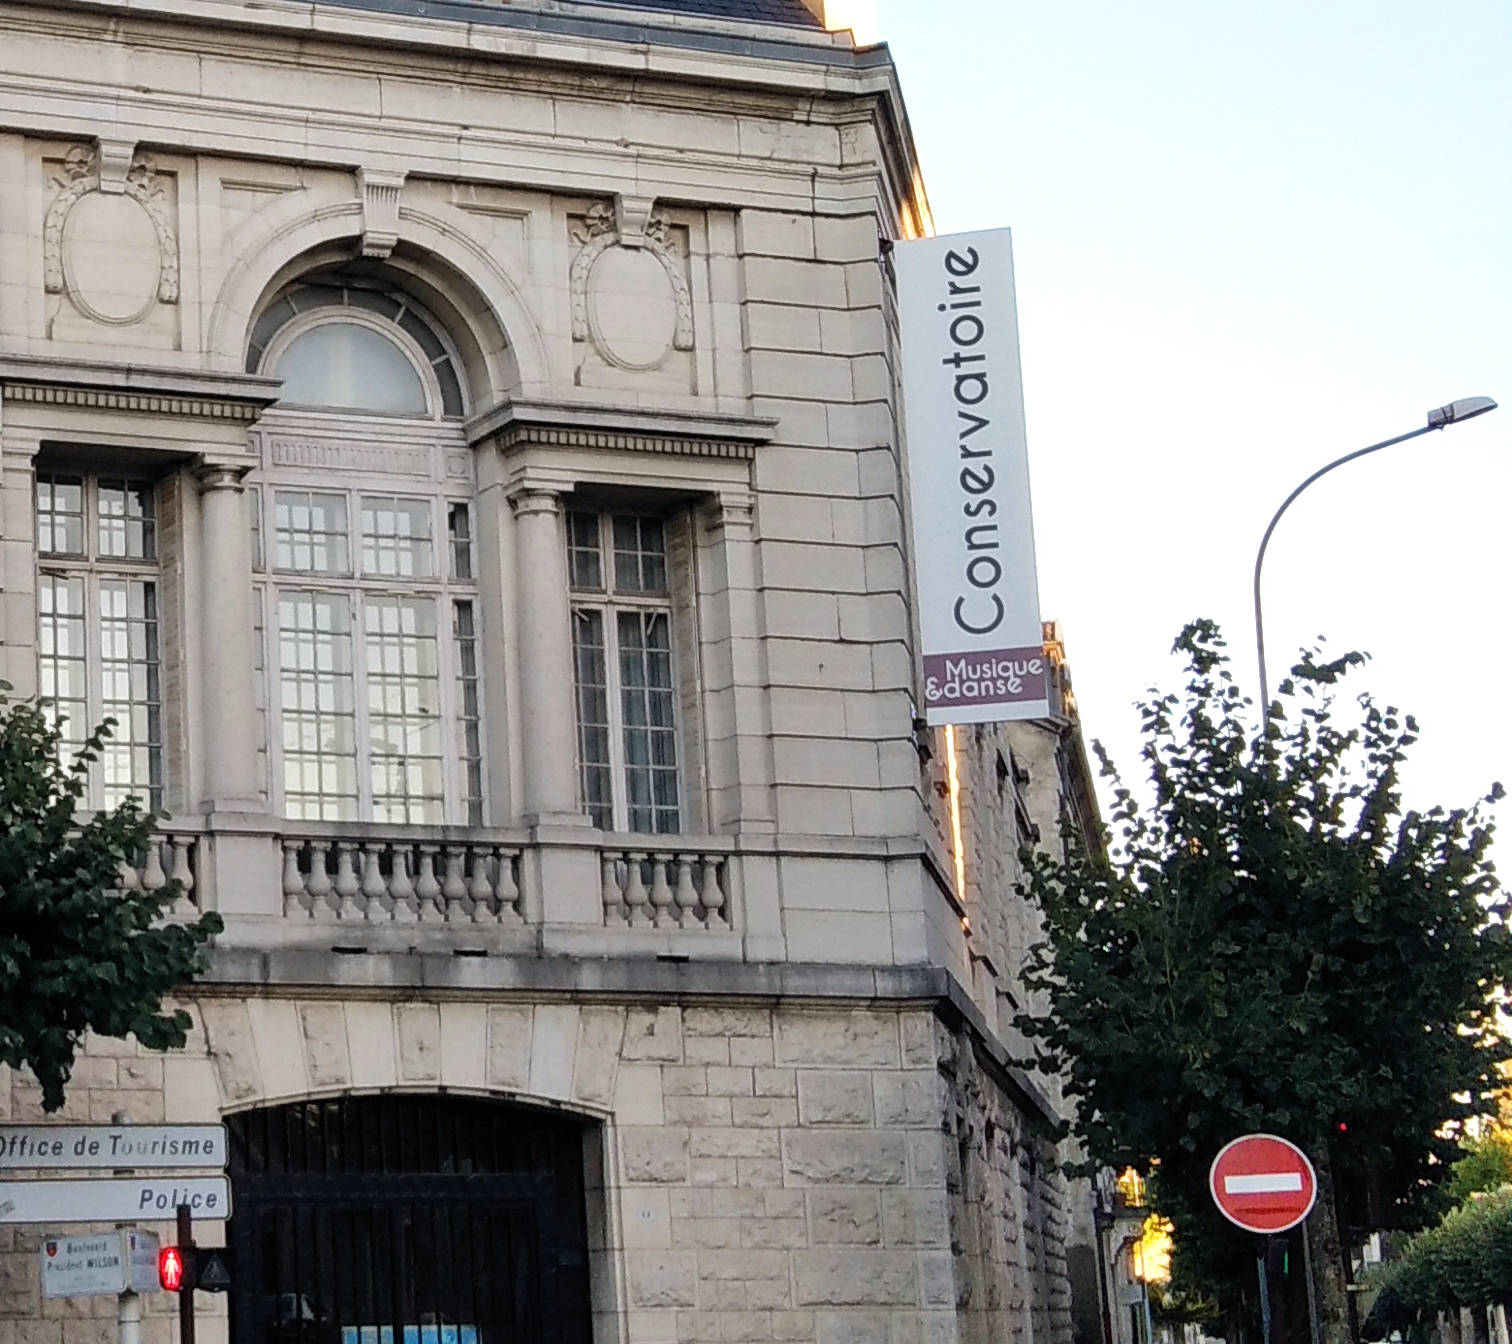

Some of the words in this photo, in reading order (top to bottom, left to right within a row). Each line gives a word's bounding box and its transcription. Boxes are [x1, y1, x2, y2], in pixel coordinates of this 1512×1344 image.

[937, 244, 1005, 635] Conservatoire
[945, 658, 1043, 681] Musique
[74, 1135, 100, 1156] de
[110, 1134, 214, 1156] Tourisme
[140, 1187, 218, 1210] Police
